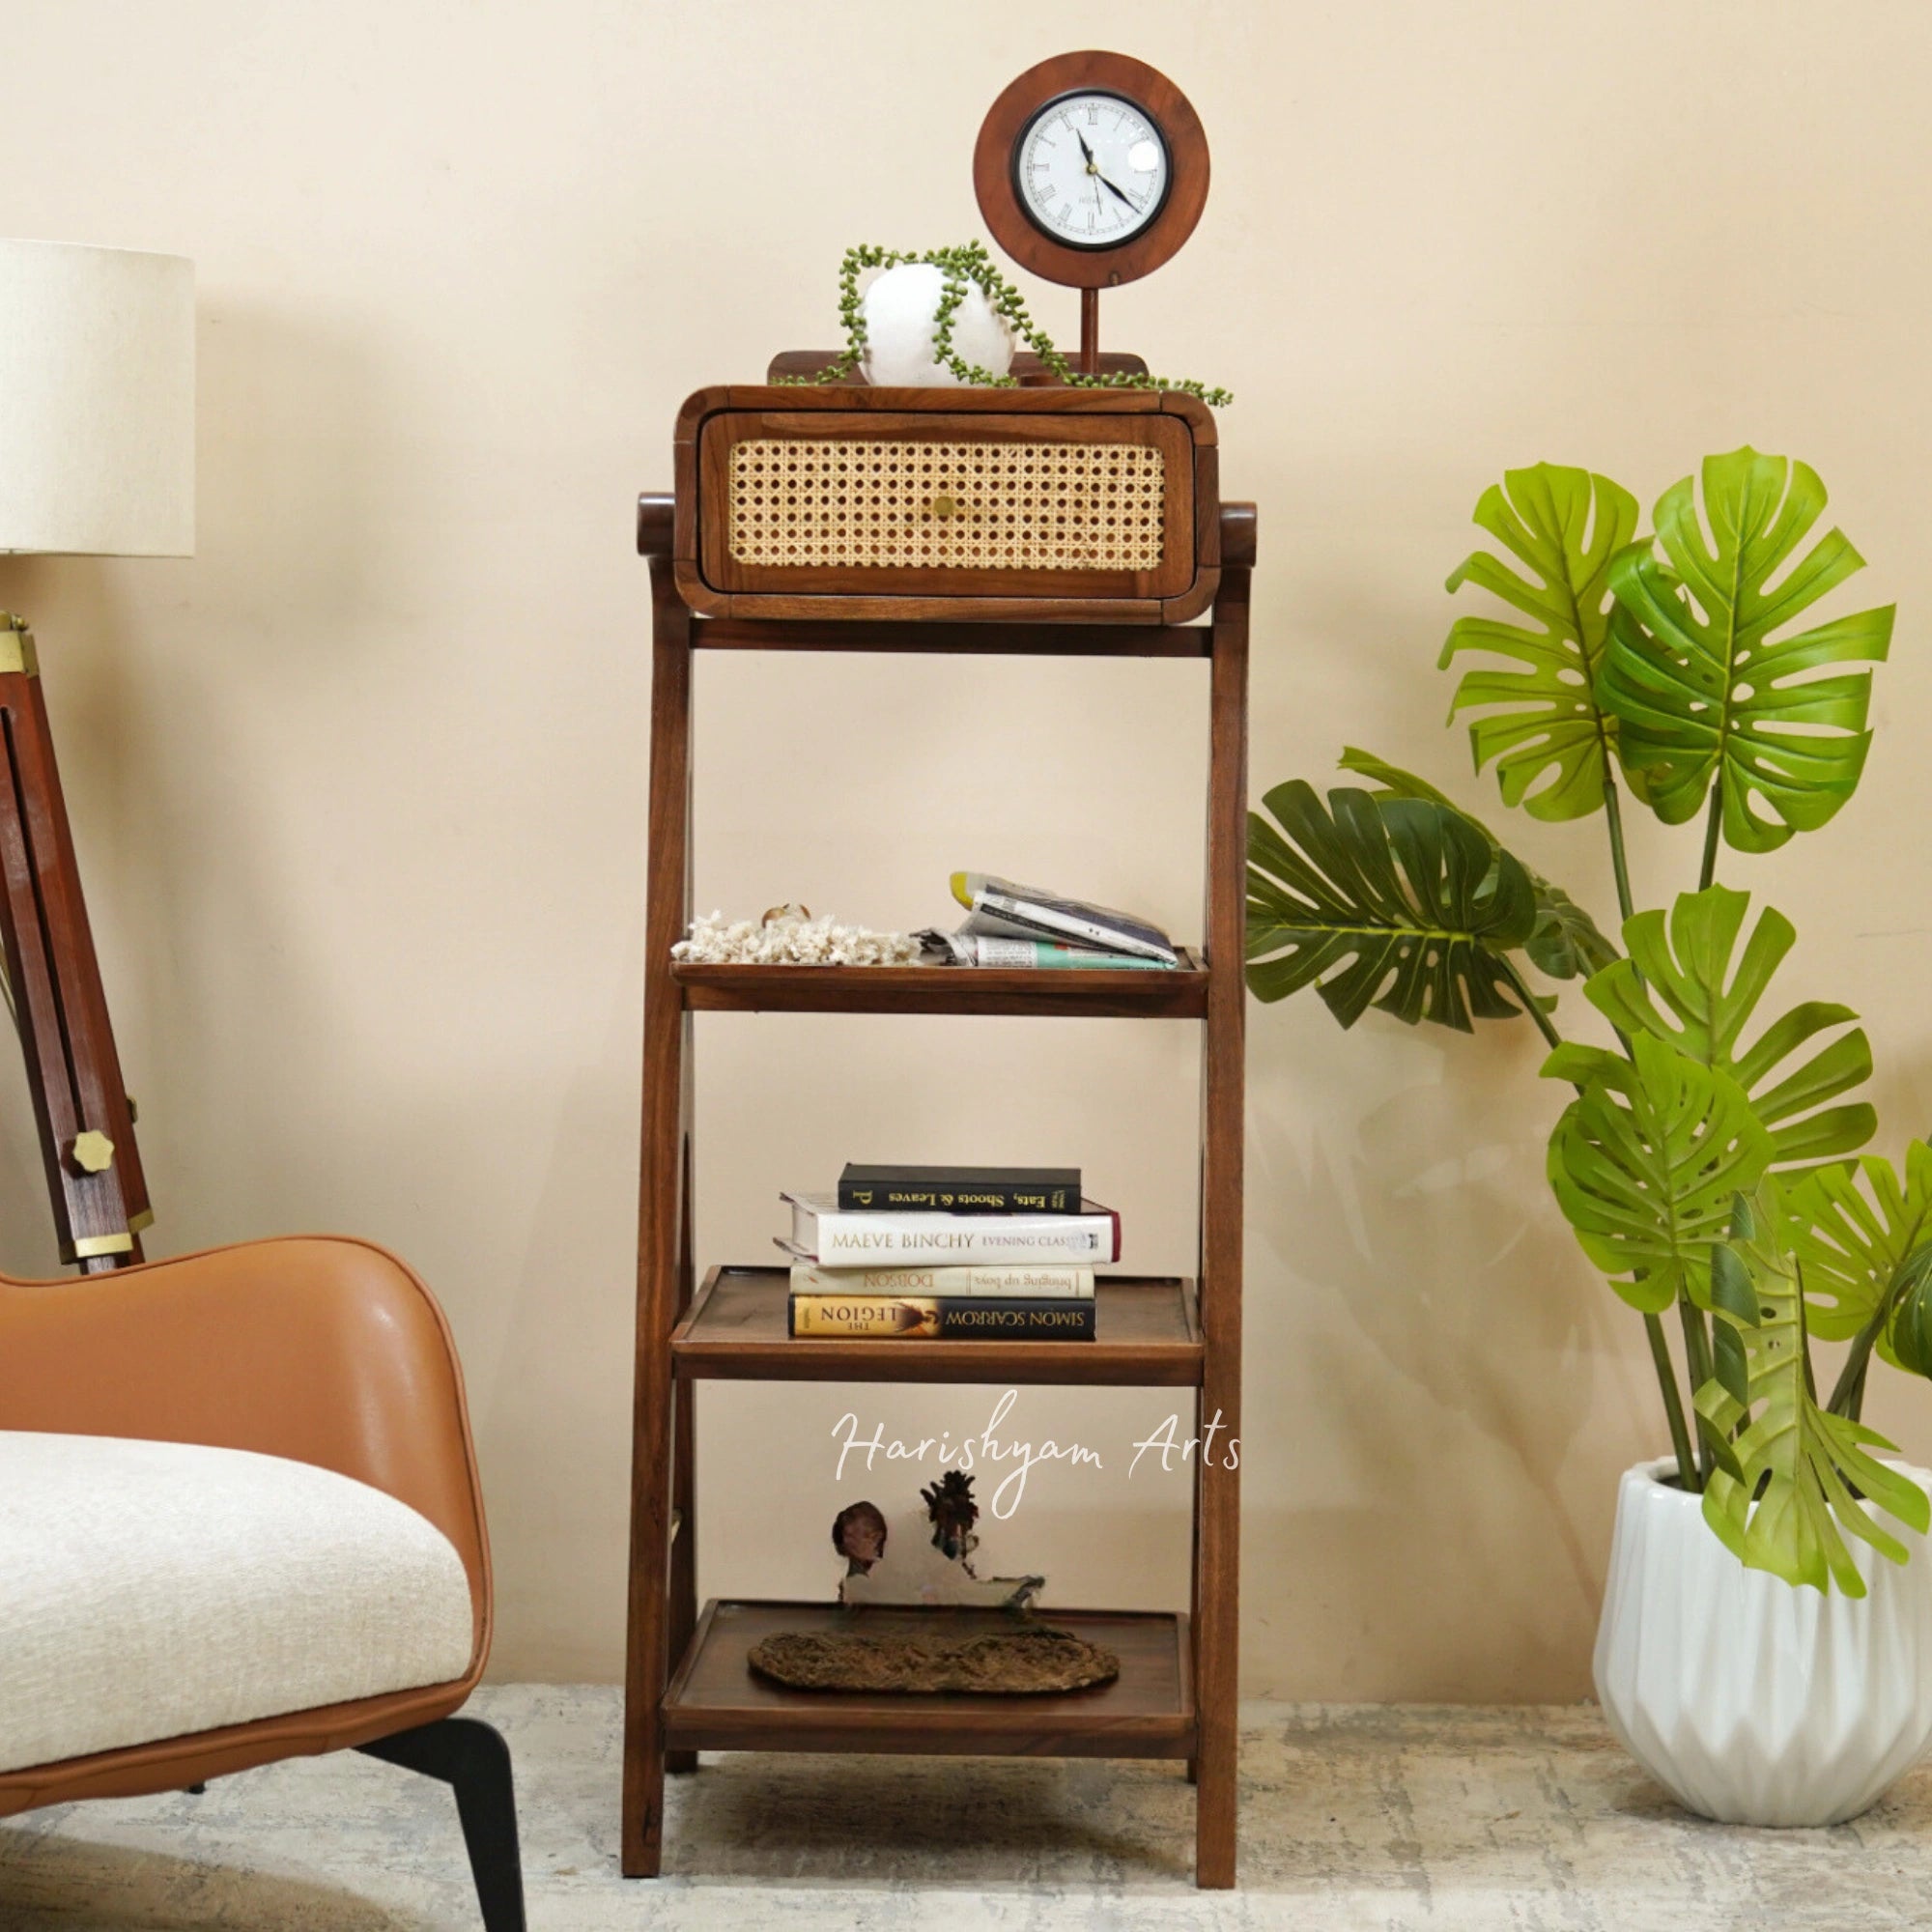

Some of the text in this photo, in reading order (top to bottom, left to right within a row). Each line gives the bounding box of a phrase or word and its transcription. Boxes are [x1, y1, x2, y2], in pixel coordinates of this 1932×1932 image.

[889, 1192, 937, 1206] Leaves
[942, 1193, 952, 1206] &
[959, 1194, 1005, 1208] Shoots
[1013, 1194, 1045, 1208] Eats,
[832, 1234, 976, 1248] MAEVE BINCHY
[982, 1236, 1036, 1246] EVENING
[864, 1274, 934, 1287] DOBSON
[1004, 1276, 1020, 1287] up
[1022, 1277, 1072, 1291] bringing
[820, 1306, 896, 1321] LEGION
[947, 1312, 1084, 1326] SIMON SCARROW
[847, 1321, 869, 1330] THE
